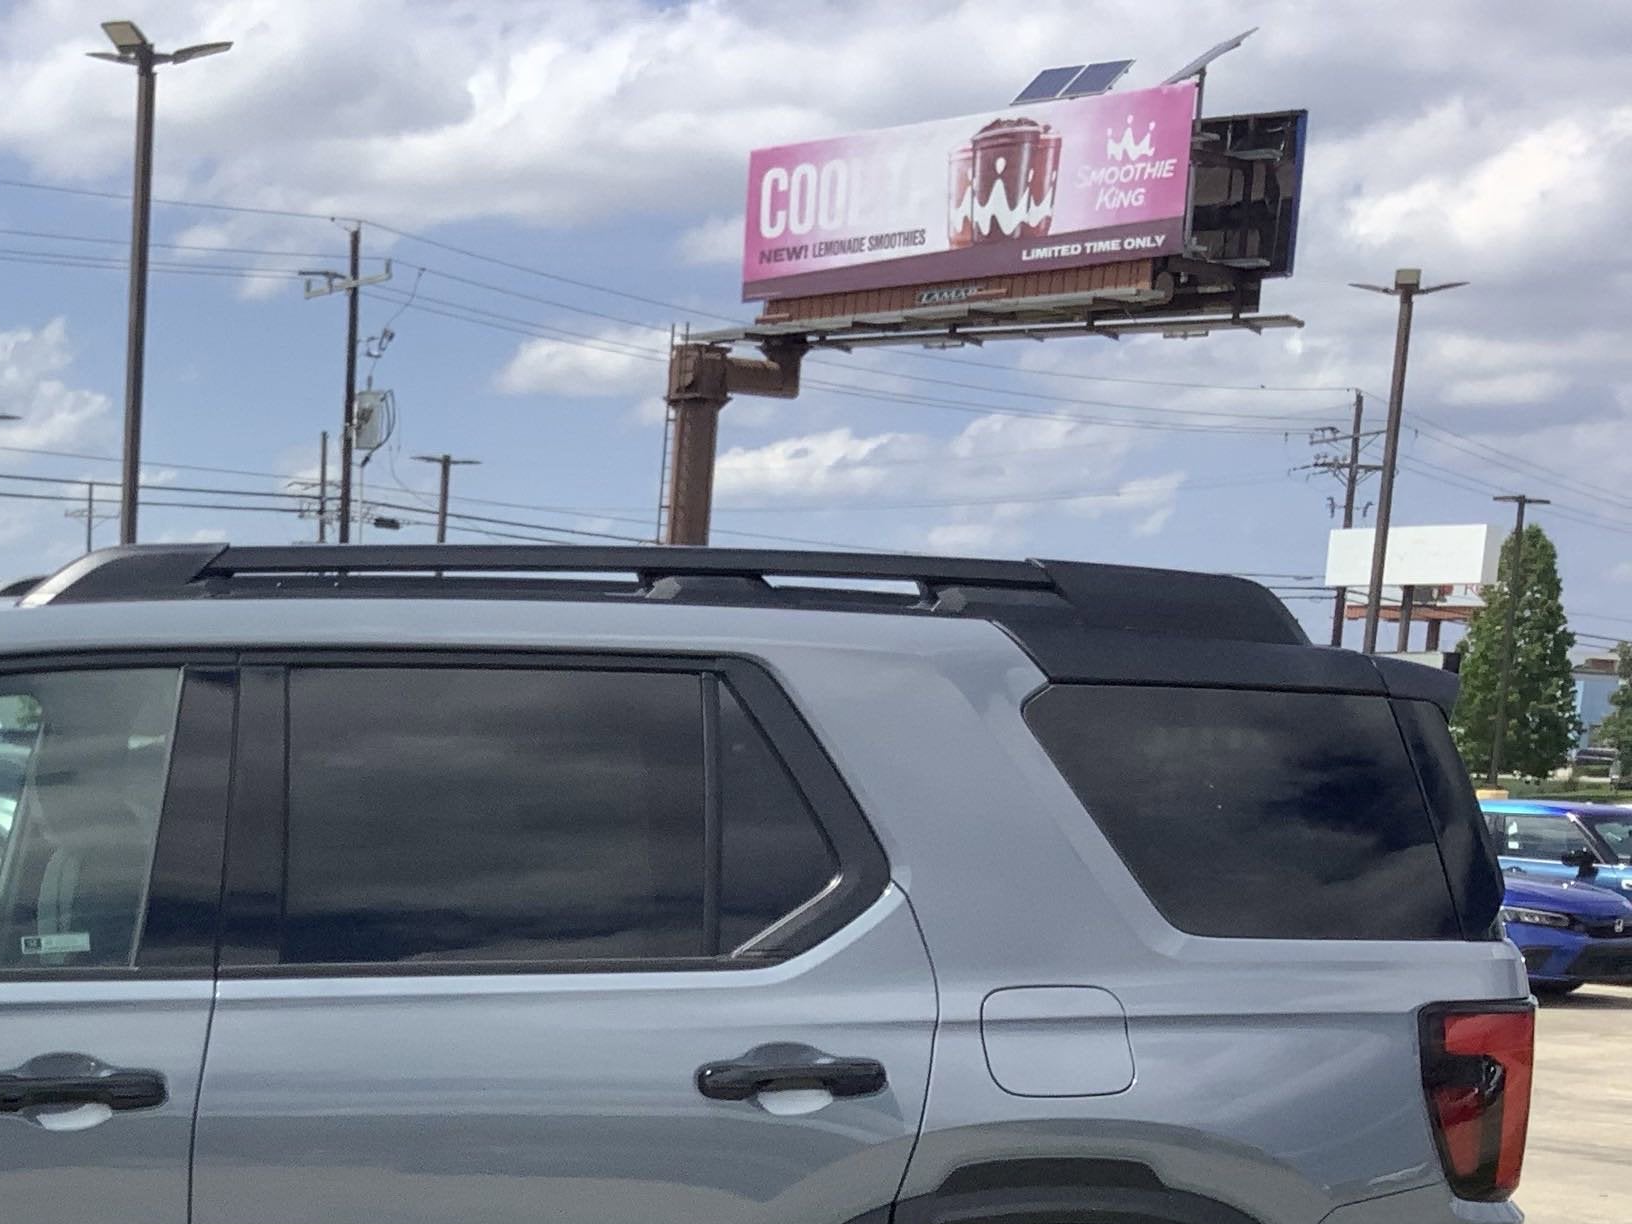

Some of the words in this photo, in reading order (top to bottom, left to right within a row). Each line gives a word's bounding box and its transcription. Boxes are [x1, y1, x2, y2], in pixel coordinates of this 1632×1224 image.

[1073, 158, 1178, 189] SMOOTHIE
[1095, 187, 1146, 211] KING
[759, 245, 808, 264] NEW!
[812, 236, 866, 258] LEMONADE
[867, 228, 926, 251] SMOOTHIES
[1022, 243, 1081, 261] LIMITED
[1084, 238, 1121, 255] TIME
[1123, 235, 1166, 250] ONLY
